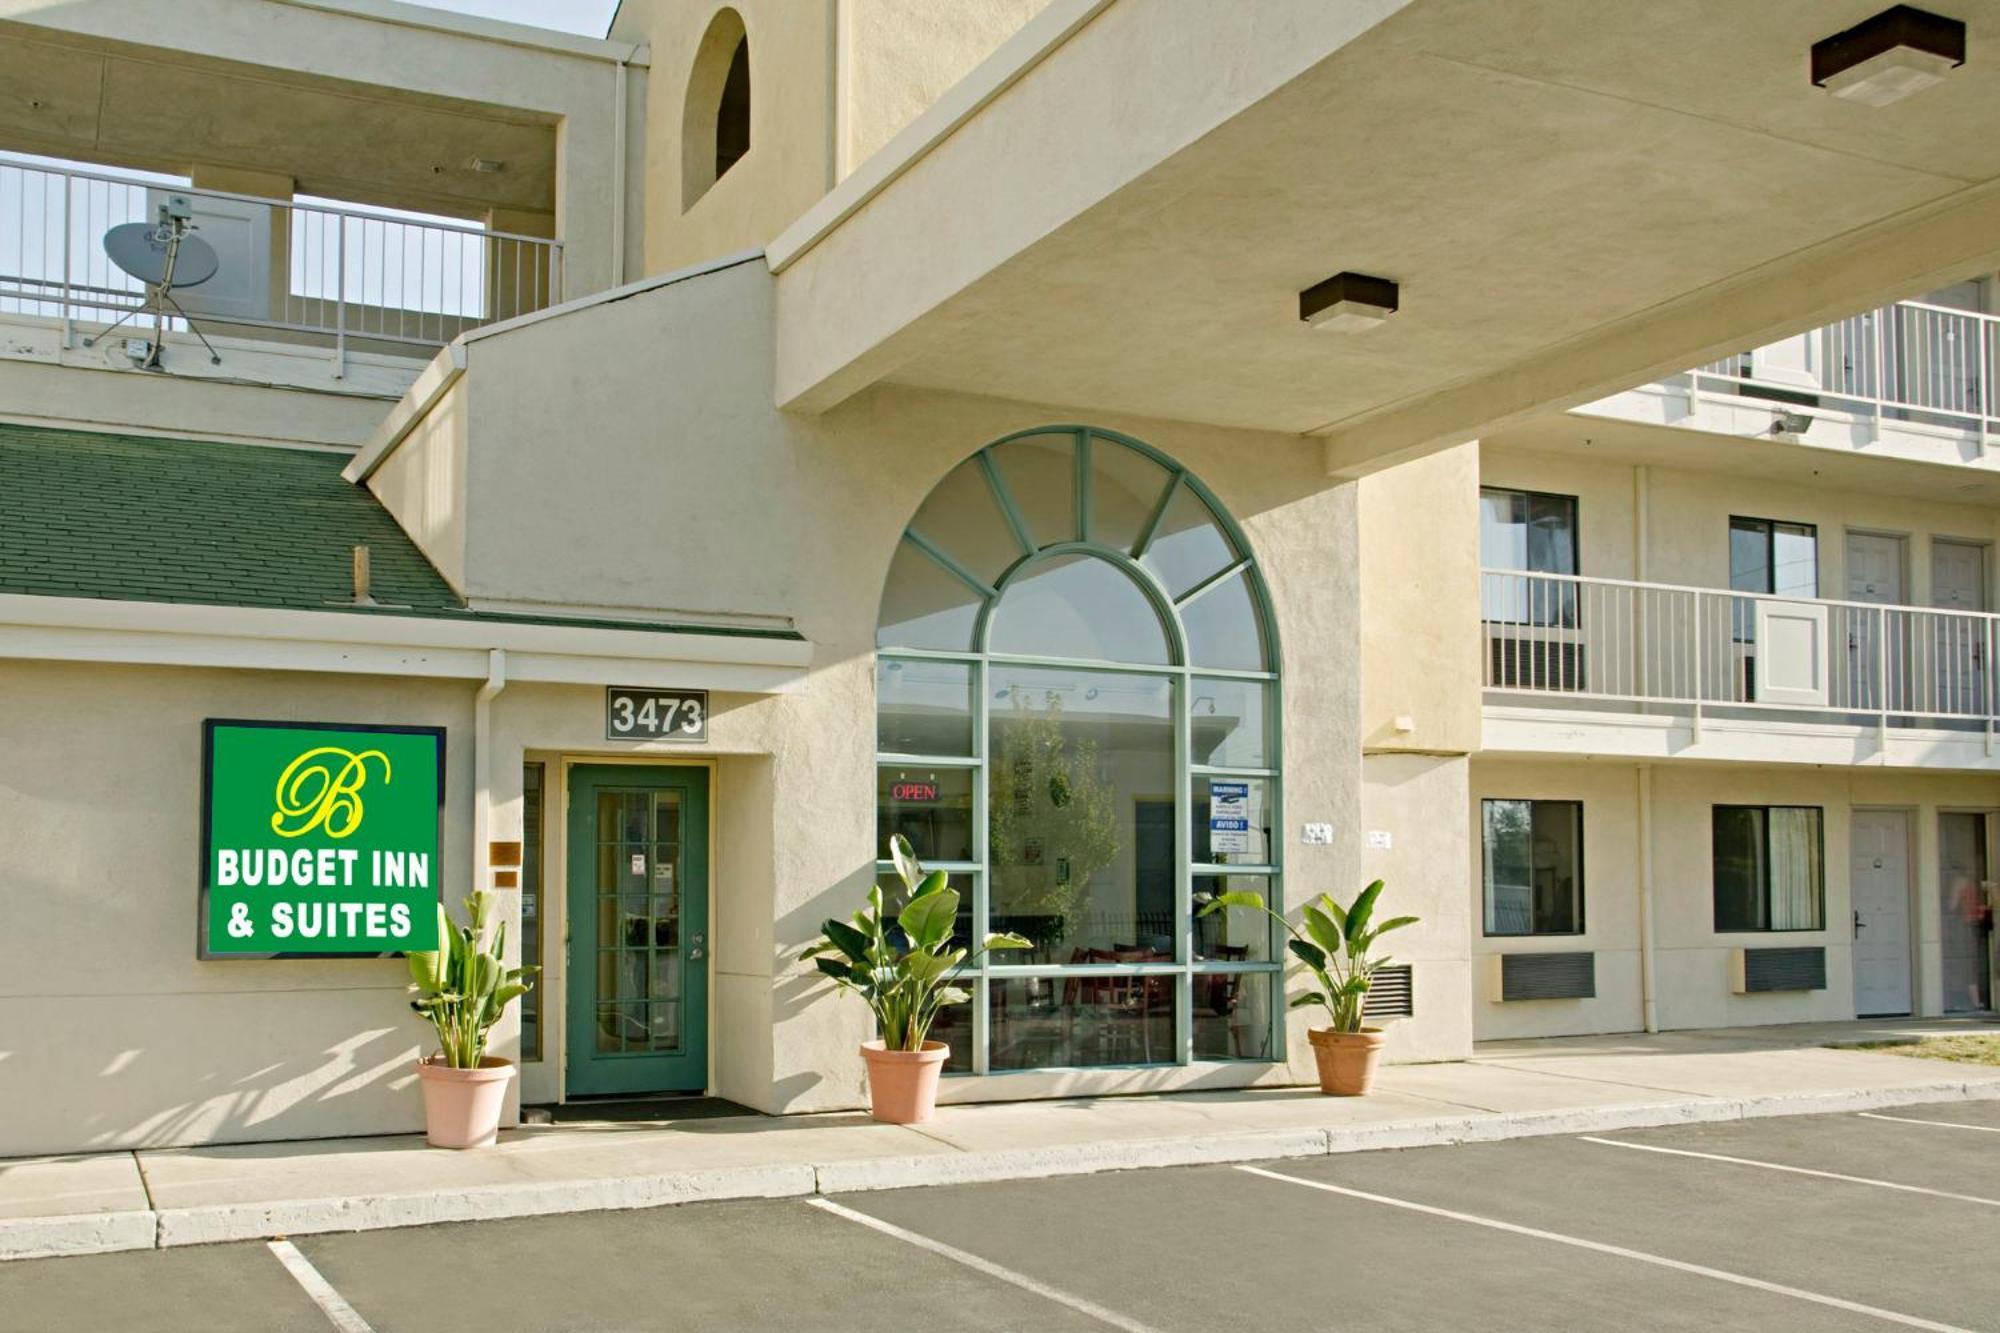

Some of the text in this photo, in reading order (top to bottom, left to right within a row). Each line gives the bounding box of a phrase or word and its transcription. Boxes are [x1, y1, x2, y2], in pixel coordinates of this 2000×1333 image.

[613, 697, 703, 734] 3473
[271, 746, 391, 839] B
[892, 784, 936, 799] OPEN
[217, 849, 429, 888] BUDGET INN
[227, 902, 412, 938] & SUITES
